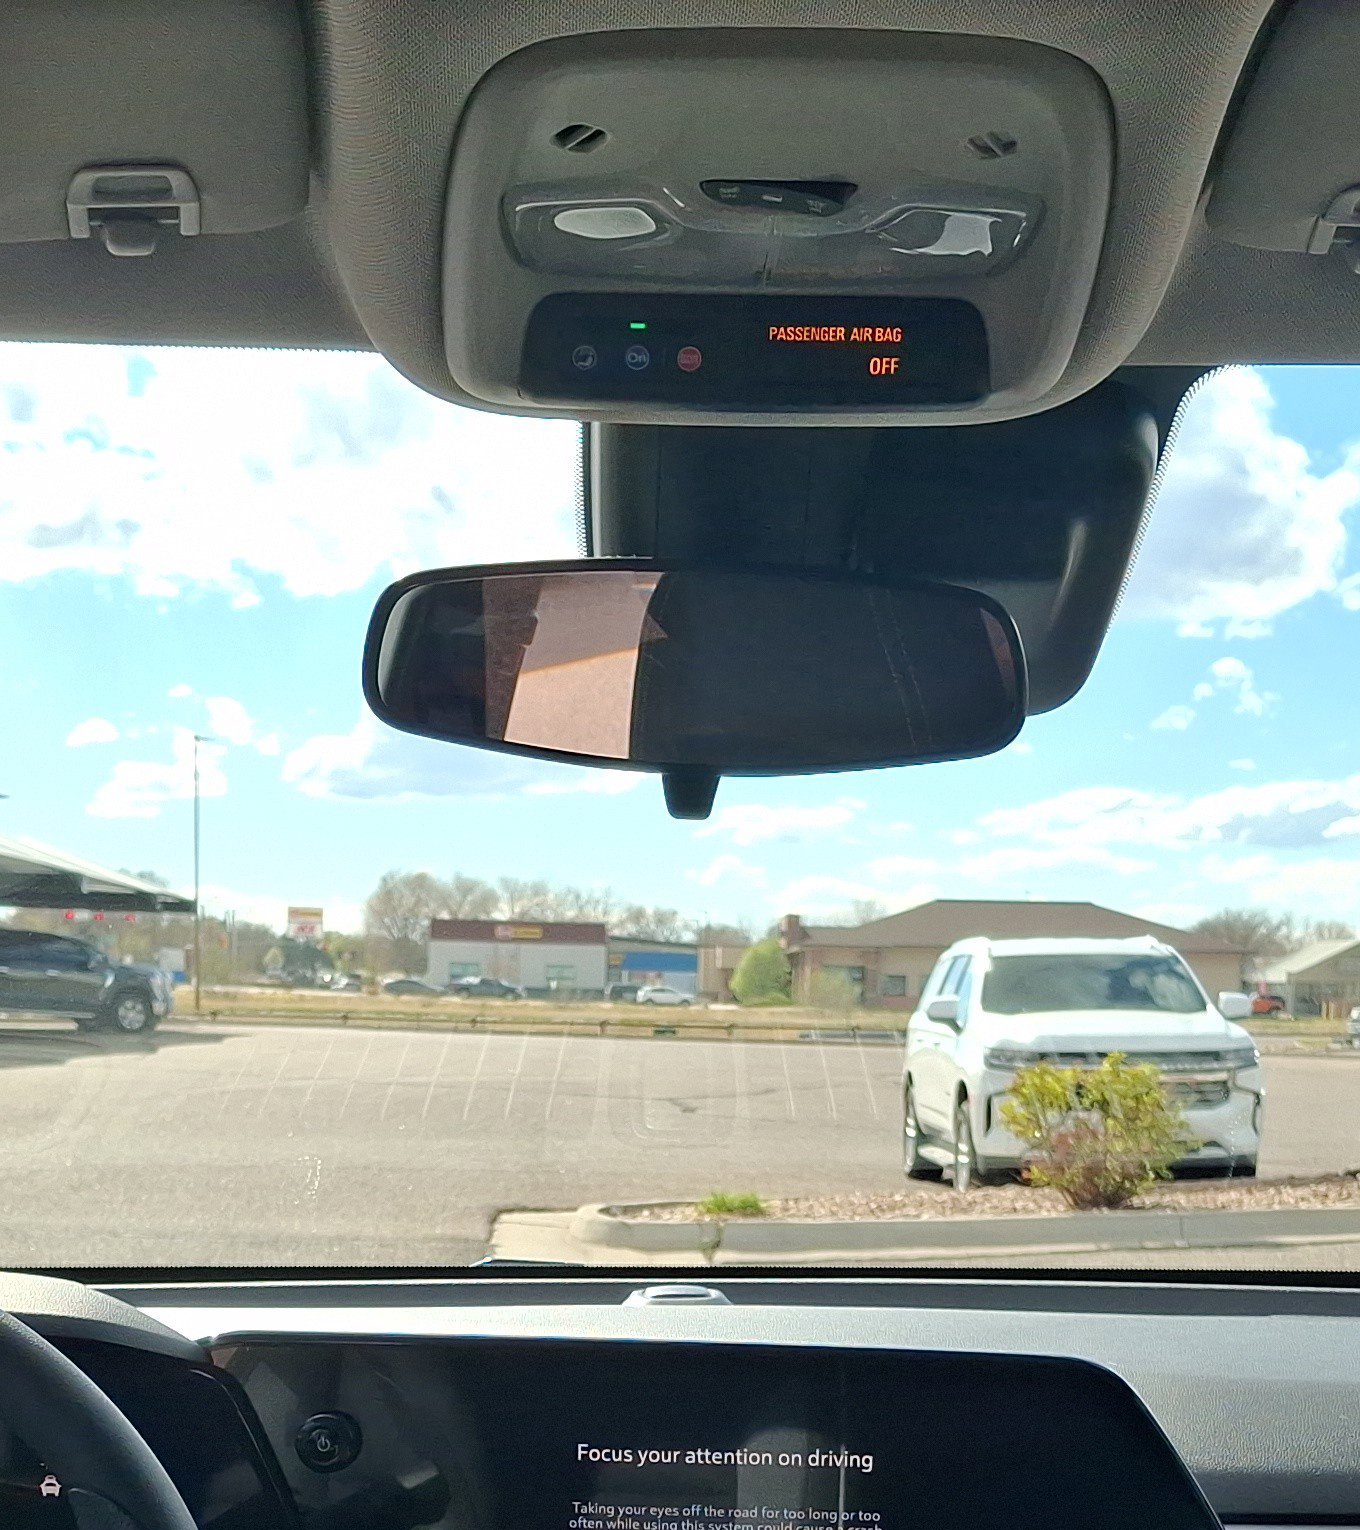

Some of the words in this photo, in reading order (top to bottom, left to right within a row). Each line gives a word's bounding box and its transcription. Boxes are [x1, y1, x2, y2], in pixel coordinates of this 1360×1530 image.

[769, 326, 845, 341] PASSENGER
[850, 327, 873, 342] AIR
[874, 327, 902, 342] BAG
[869, 357, 900, 375] OFF
[577, 1443, 633, 1462] Focus
[636, 1449, 681, 1467] your
[685, 1448, 772, 1466] attention
[778, 1452, 802, 1467] on
[807, 1448, 874, 1473] driving
[571, 1501, 615, 1517] Taking
[617, 1505, 648, 1519] your
[649, 1507, 679, 1519] eyes
[682, 1504, 702, 1517] off
[704, 1505, 725, 1517] the
[728, 1506, 758, 1519] road
[761, 1505, 780, 1519] for
[783, 1507, 806, 1520] too
[808, 1507, 838, 1523] long
[840, 1511, 855, 1521] or
[858, 1510, 881, 1522] too
[569, 1516, 603, 1529] often
[606, 1517, 640, 1530] while
